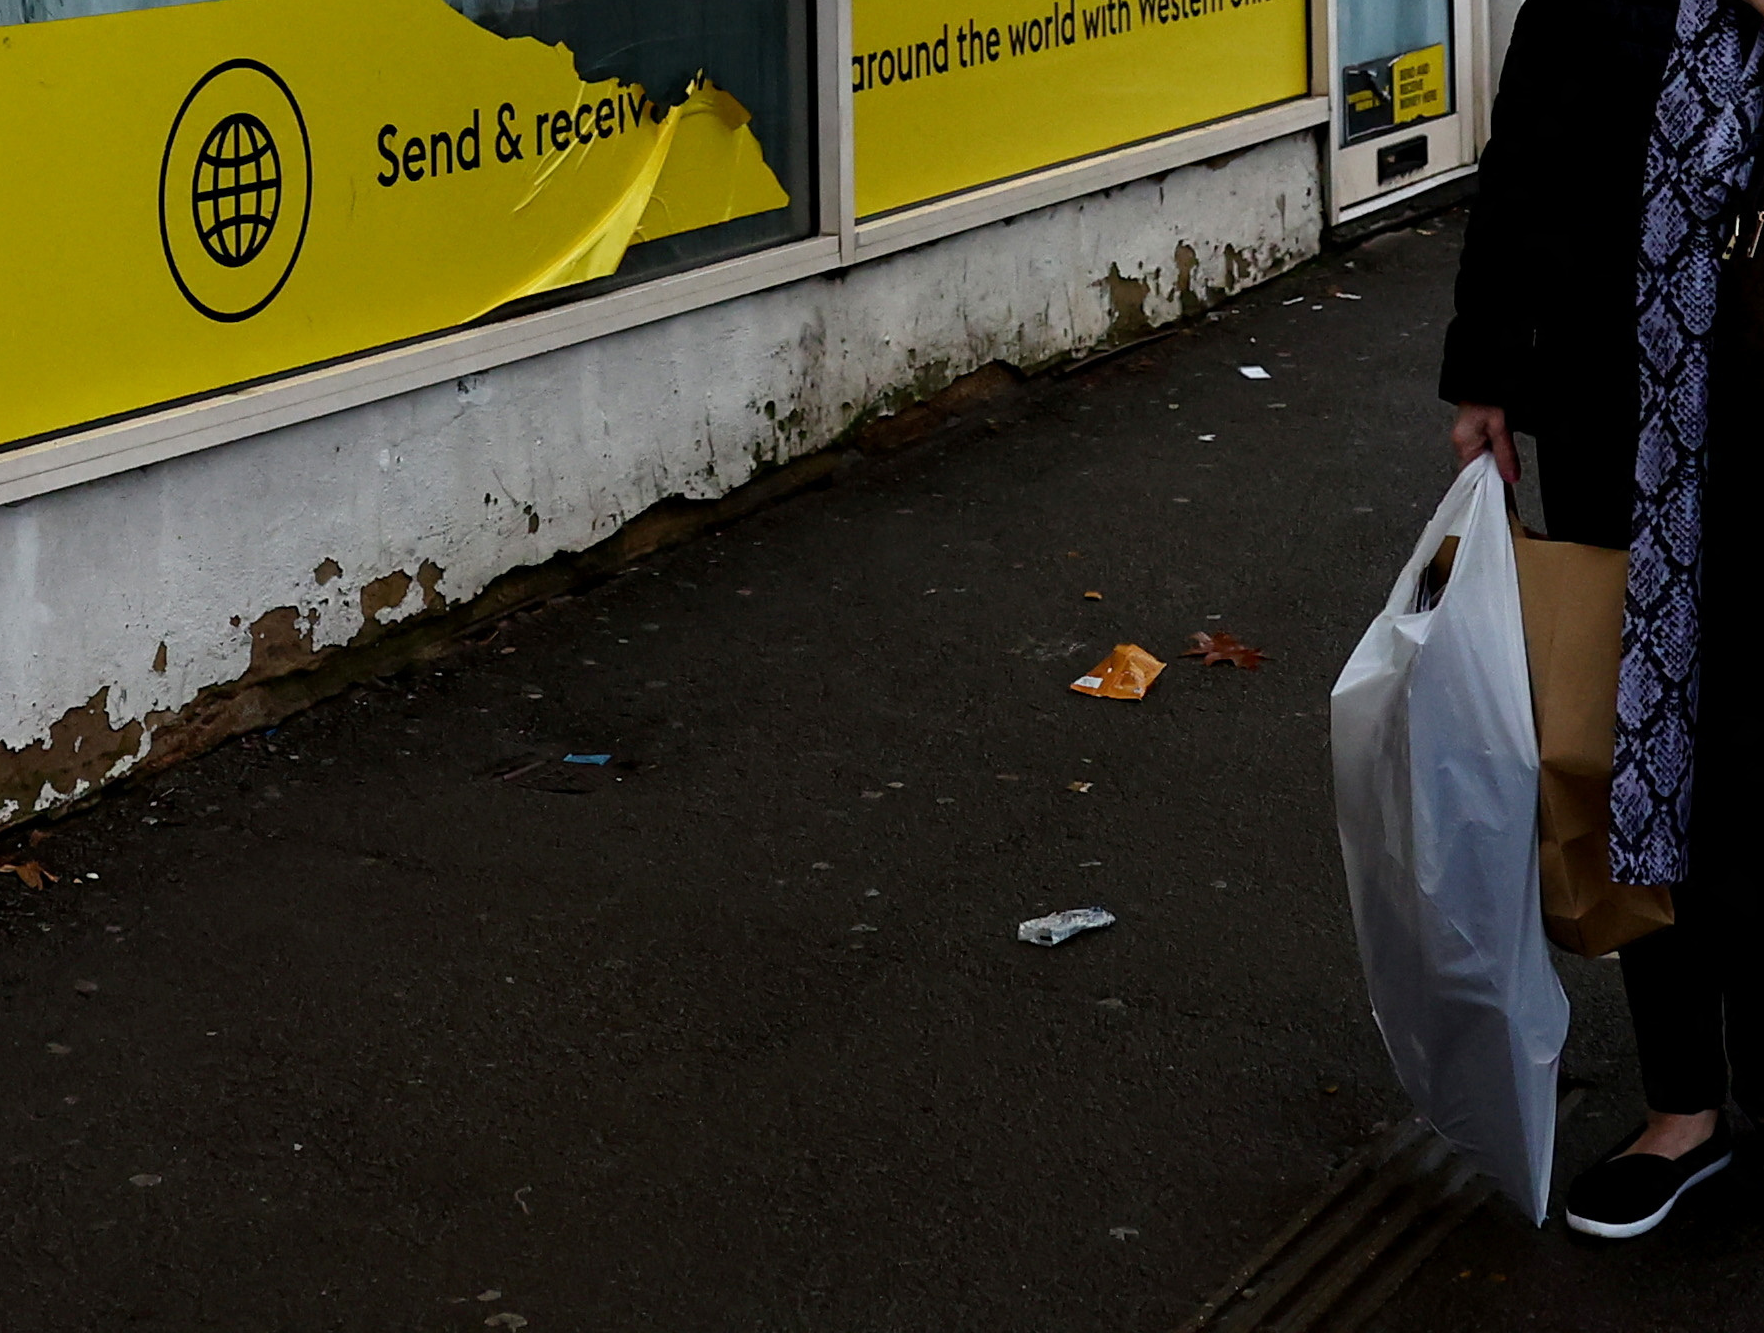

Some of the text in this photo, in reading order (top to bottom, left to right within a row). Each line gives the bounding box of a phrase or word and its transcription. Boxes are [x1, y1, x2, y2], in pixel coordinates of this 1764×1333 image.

[851, 24, 949, 93] around
[957, 18, 1002, 69] the
[377, 108, 482, 188] Send
[495, 102, 524, 163] &
